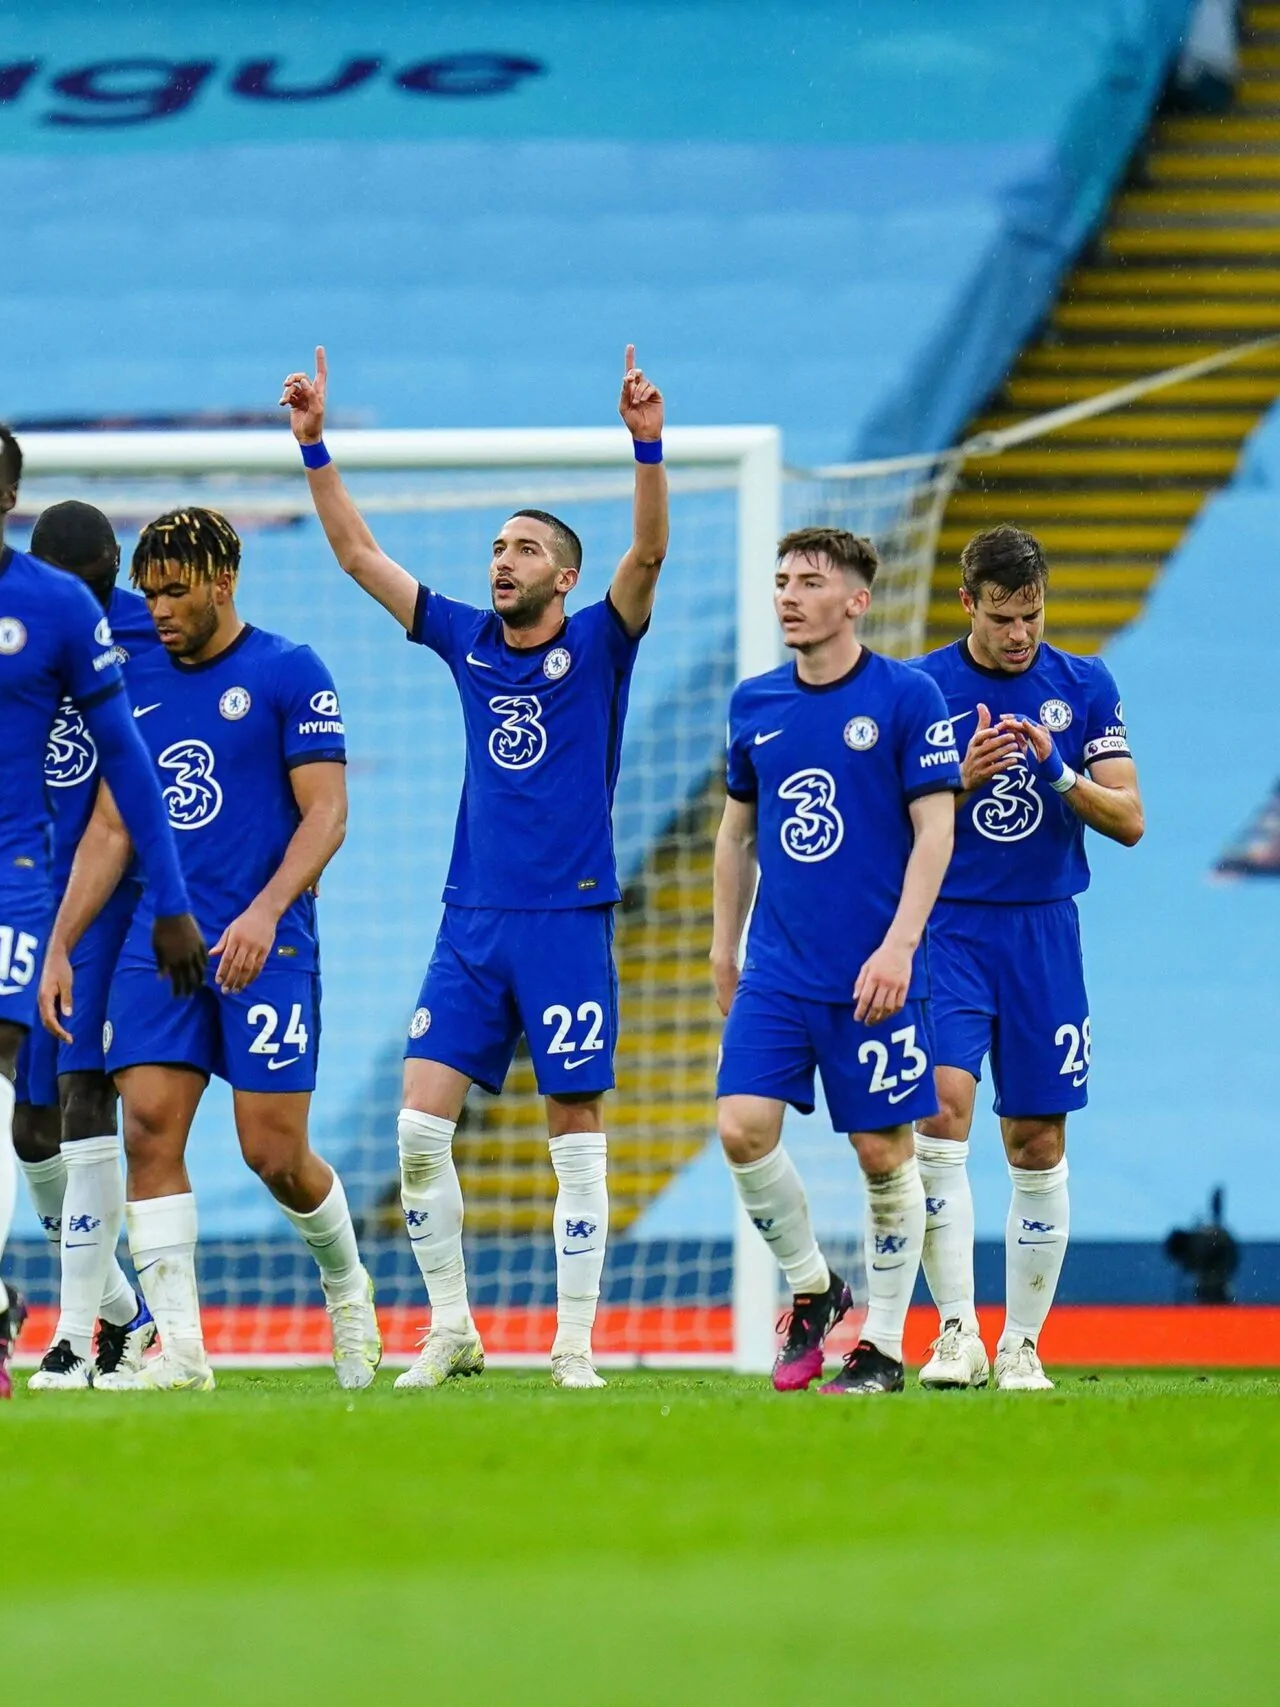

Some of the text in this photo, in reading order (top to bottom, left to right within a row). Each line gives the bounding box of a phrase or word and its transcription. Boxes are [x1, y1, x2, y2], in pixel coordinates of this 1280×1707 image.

[488, 694, 547, 770] 3
[157, 739, 223, 830] 3
[777, 767, 844, 863] 3
[247, 1003, 309, 1054] 24
[542, 1001, 605, 1055] 22
[857, 1024, 928, 1094] 23
